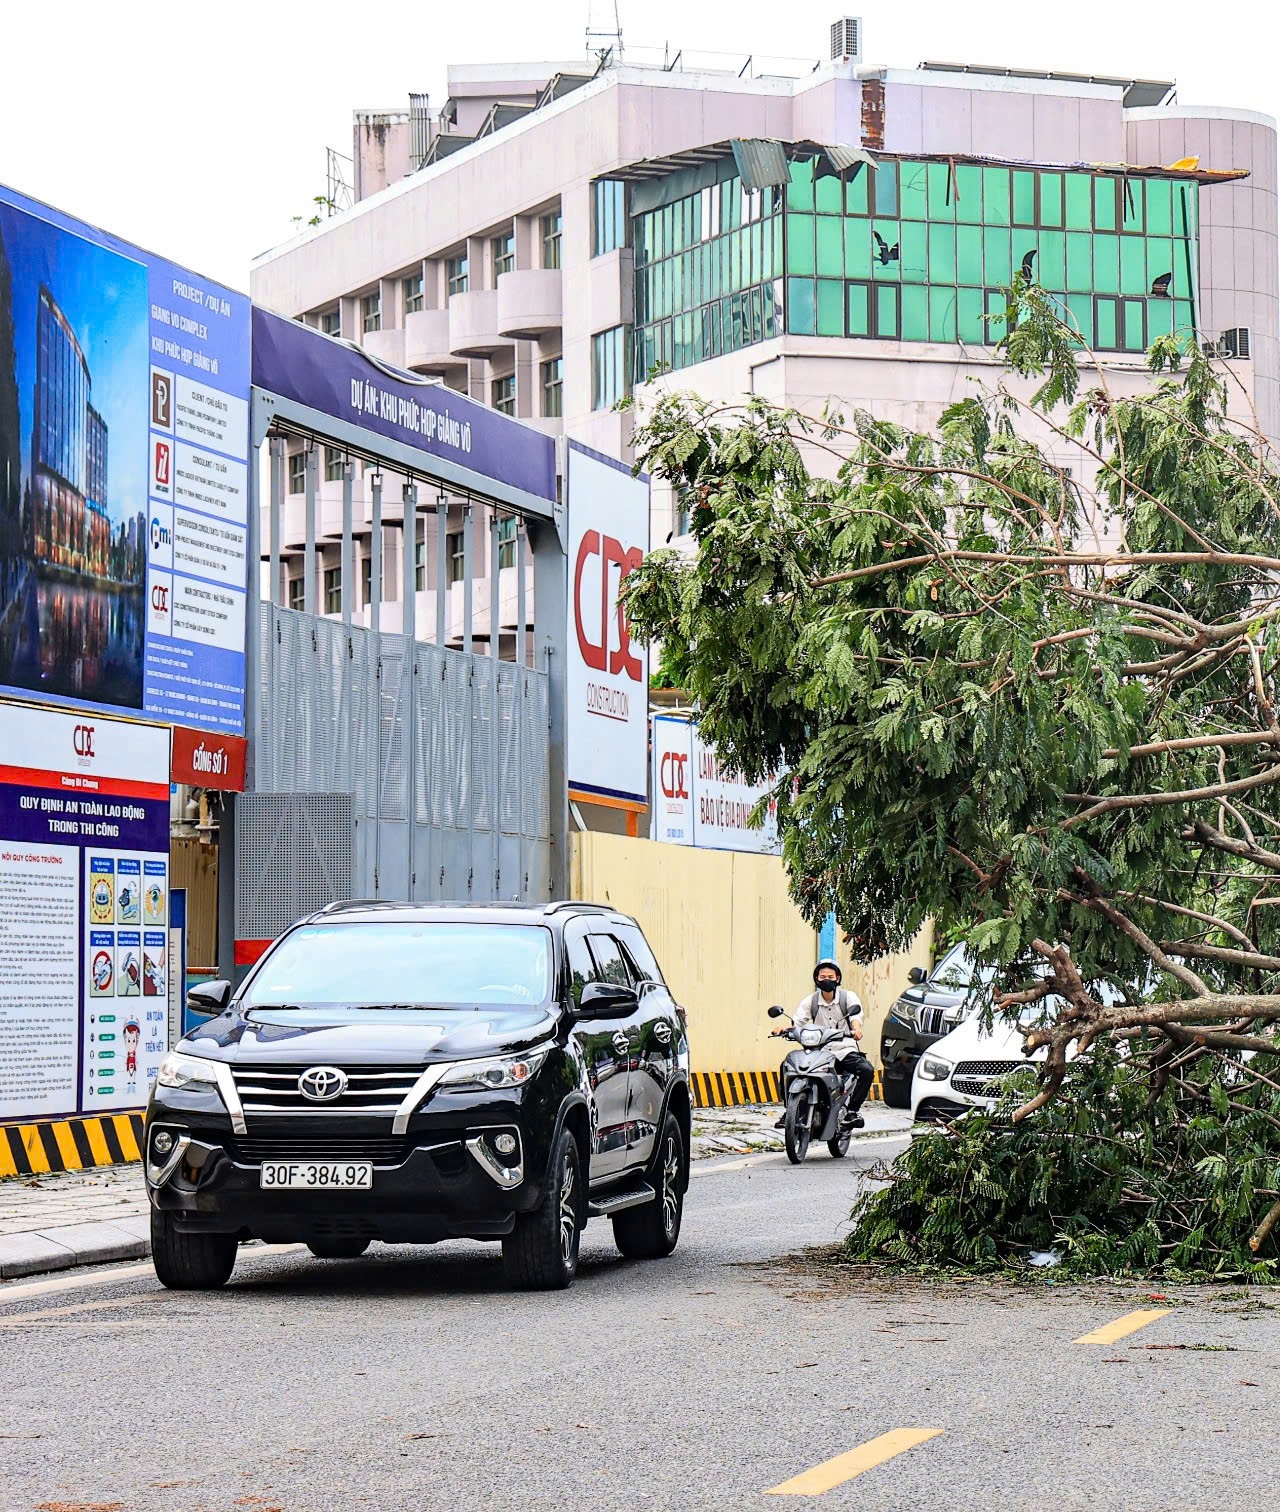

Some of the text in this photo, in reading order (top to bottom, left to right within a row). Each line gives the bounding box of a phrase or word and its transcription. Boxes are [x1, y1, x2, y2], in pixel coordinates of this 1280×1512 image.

[172, 280, 204, 304] PROJECT
[152, 304, 170, 324] GIANG
[180, 316, 208, 340] COMPLEX
[152, 336, 164, 354] KHU
[351, 378, 472, 453] DỰ ÁN: KHU PHỨC HỢP GIẢNG VÕ
[212, 748, 224, 774] SỐ
[224, 754, 228, 774] 1
[20, 796, 145, 820] QUY ĐỊNH AN TOÀN LAO ĐỘNG
[726, 800, 736, 828] GIA
[48, 819, 119, 837] TRONG THI CÔNG
[146, 1068, 159, 1078] SAFET
[265, 1166, 368, 1185] 30F-384.92
